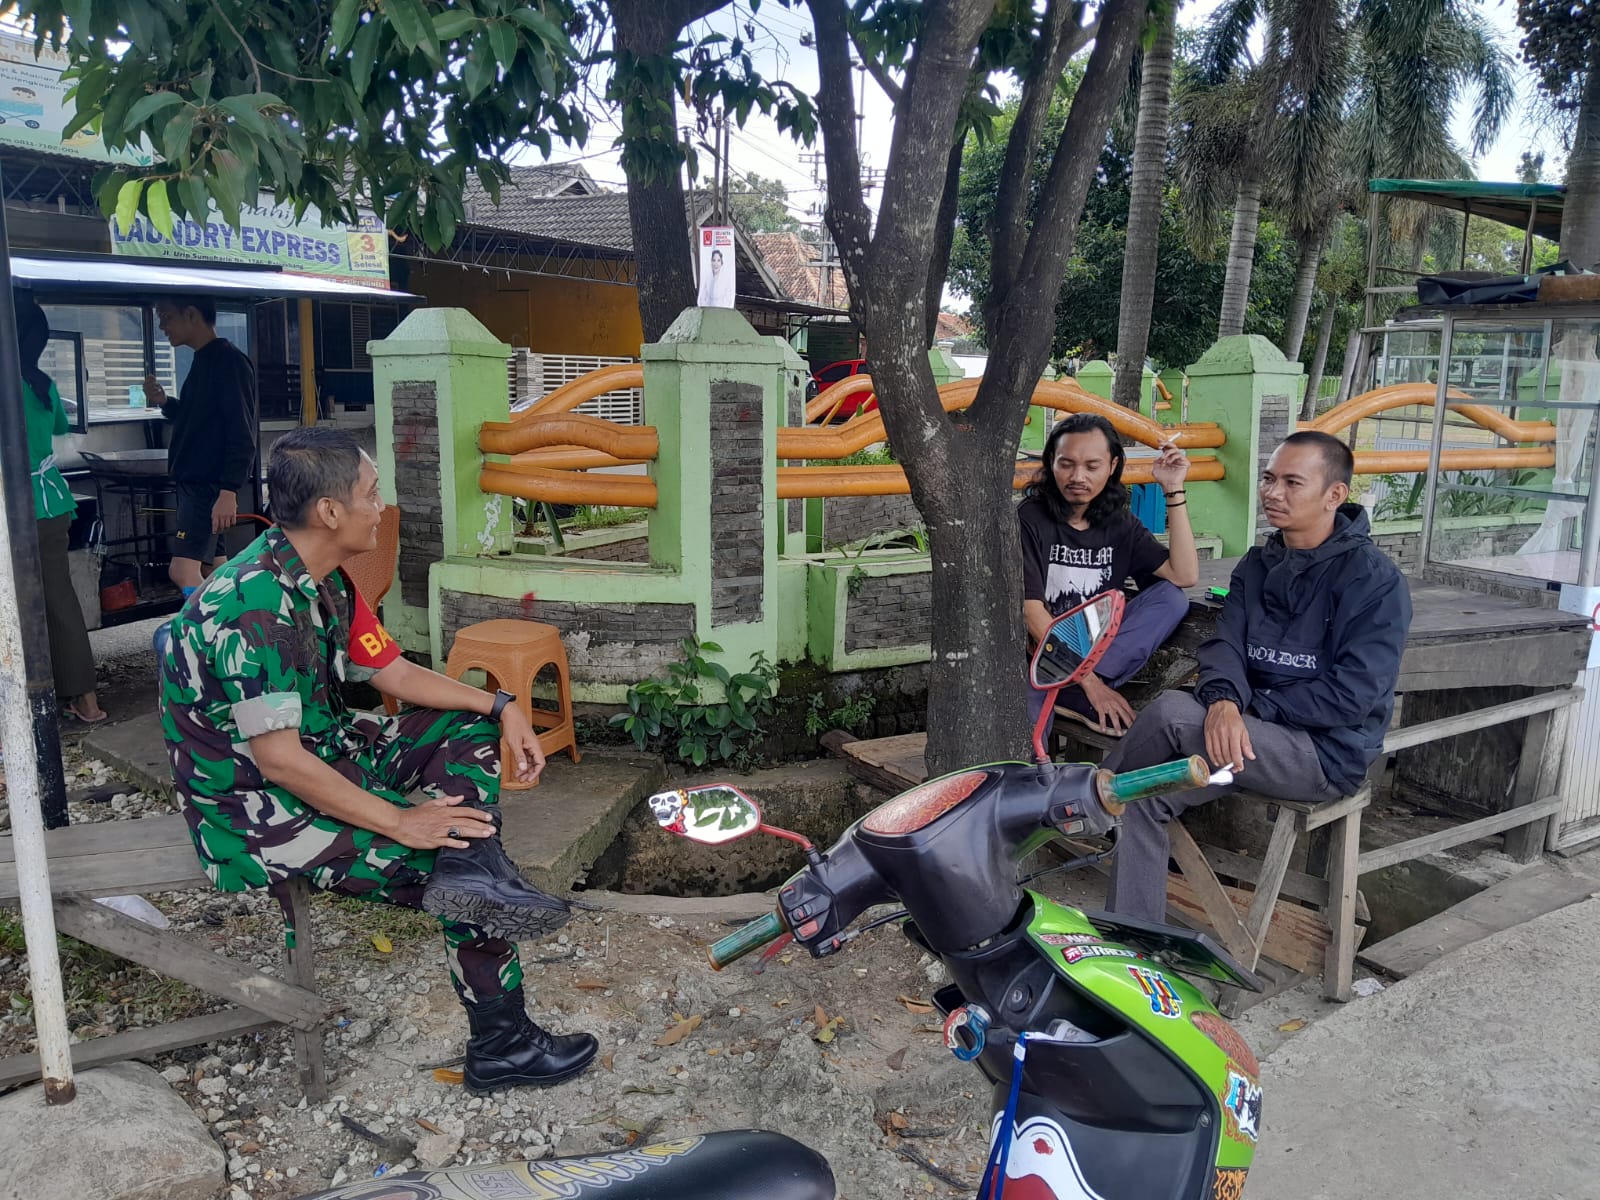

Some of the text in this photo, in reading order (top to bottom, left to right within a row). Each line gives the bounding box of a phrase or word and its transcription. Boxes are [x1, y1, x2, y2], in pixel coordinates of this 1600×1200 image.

[113, 218, 233, 249] LAUNDRY
[241, 226, 341, 264] EXPRESS
[359, 234, 375, 253] 3
[359, 623, 394, 658] BA
